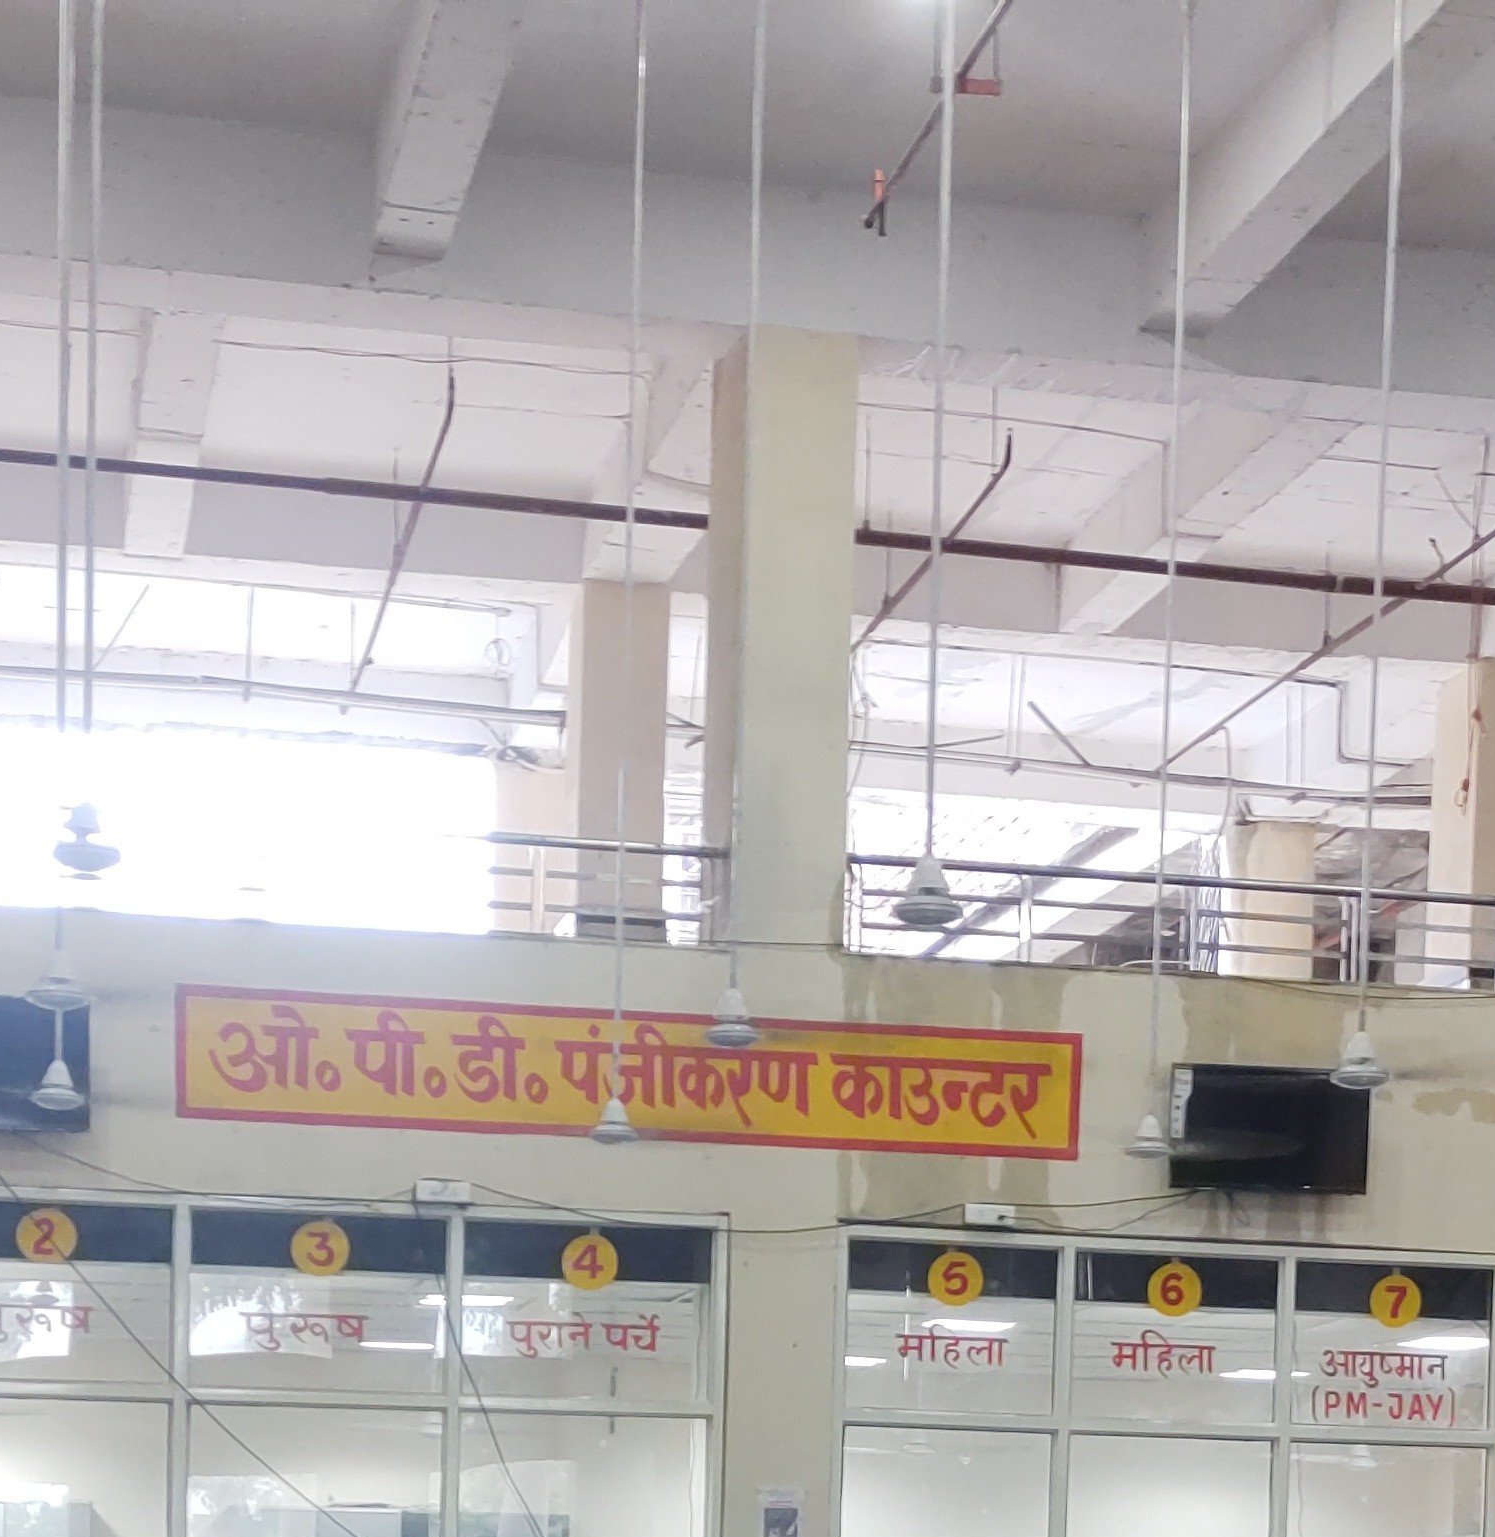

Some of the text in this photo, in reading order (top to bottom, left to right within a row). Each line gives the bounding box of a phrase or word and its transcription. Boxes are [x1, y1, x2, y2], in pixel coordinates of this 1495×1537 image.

[554, 1023, 818, 1128] पंजीकरण
[830, 1052, 1052, 1140] काउन्टर
[32, 1217, 55, 1256] 2
[306, 1231, 335, 1267] 3
[571, 1244, 604, 1280] 4
[941, 1260, 970, 1296] 5
[1160, 1272, 1185, 1307] 6
[1384, 1285, 1408, 1320] 7
[505, 1311, 593, 1360] पुराने
[894, 1323, 1009, 1369] महिला
[1110, 1329, 1218, 1379] महिला
[1318, 1350, 1449, 1388] आयुष्मान
